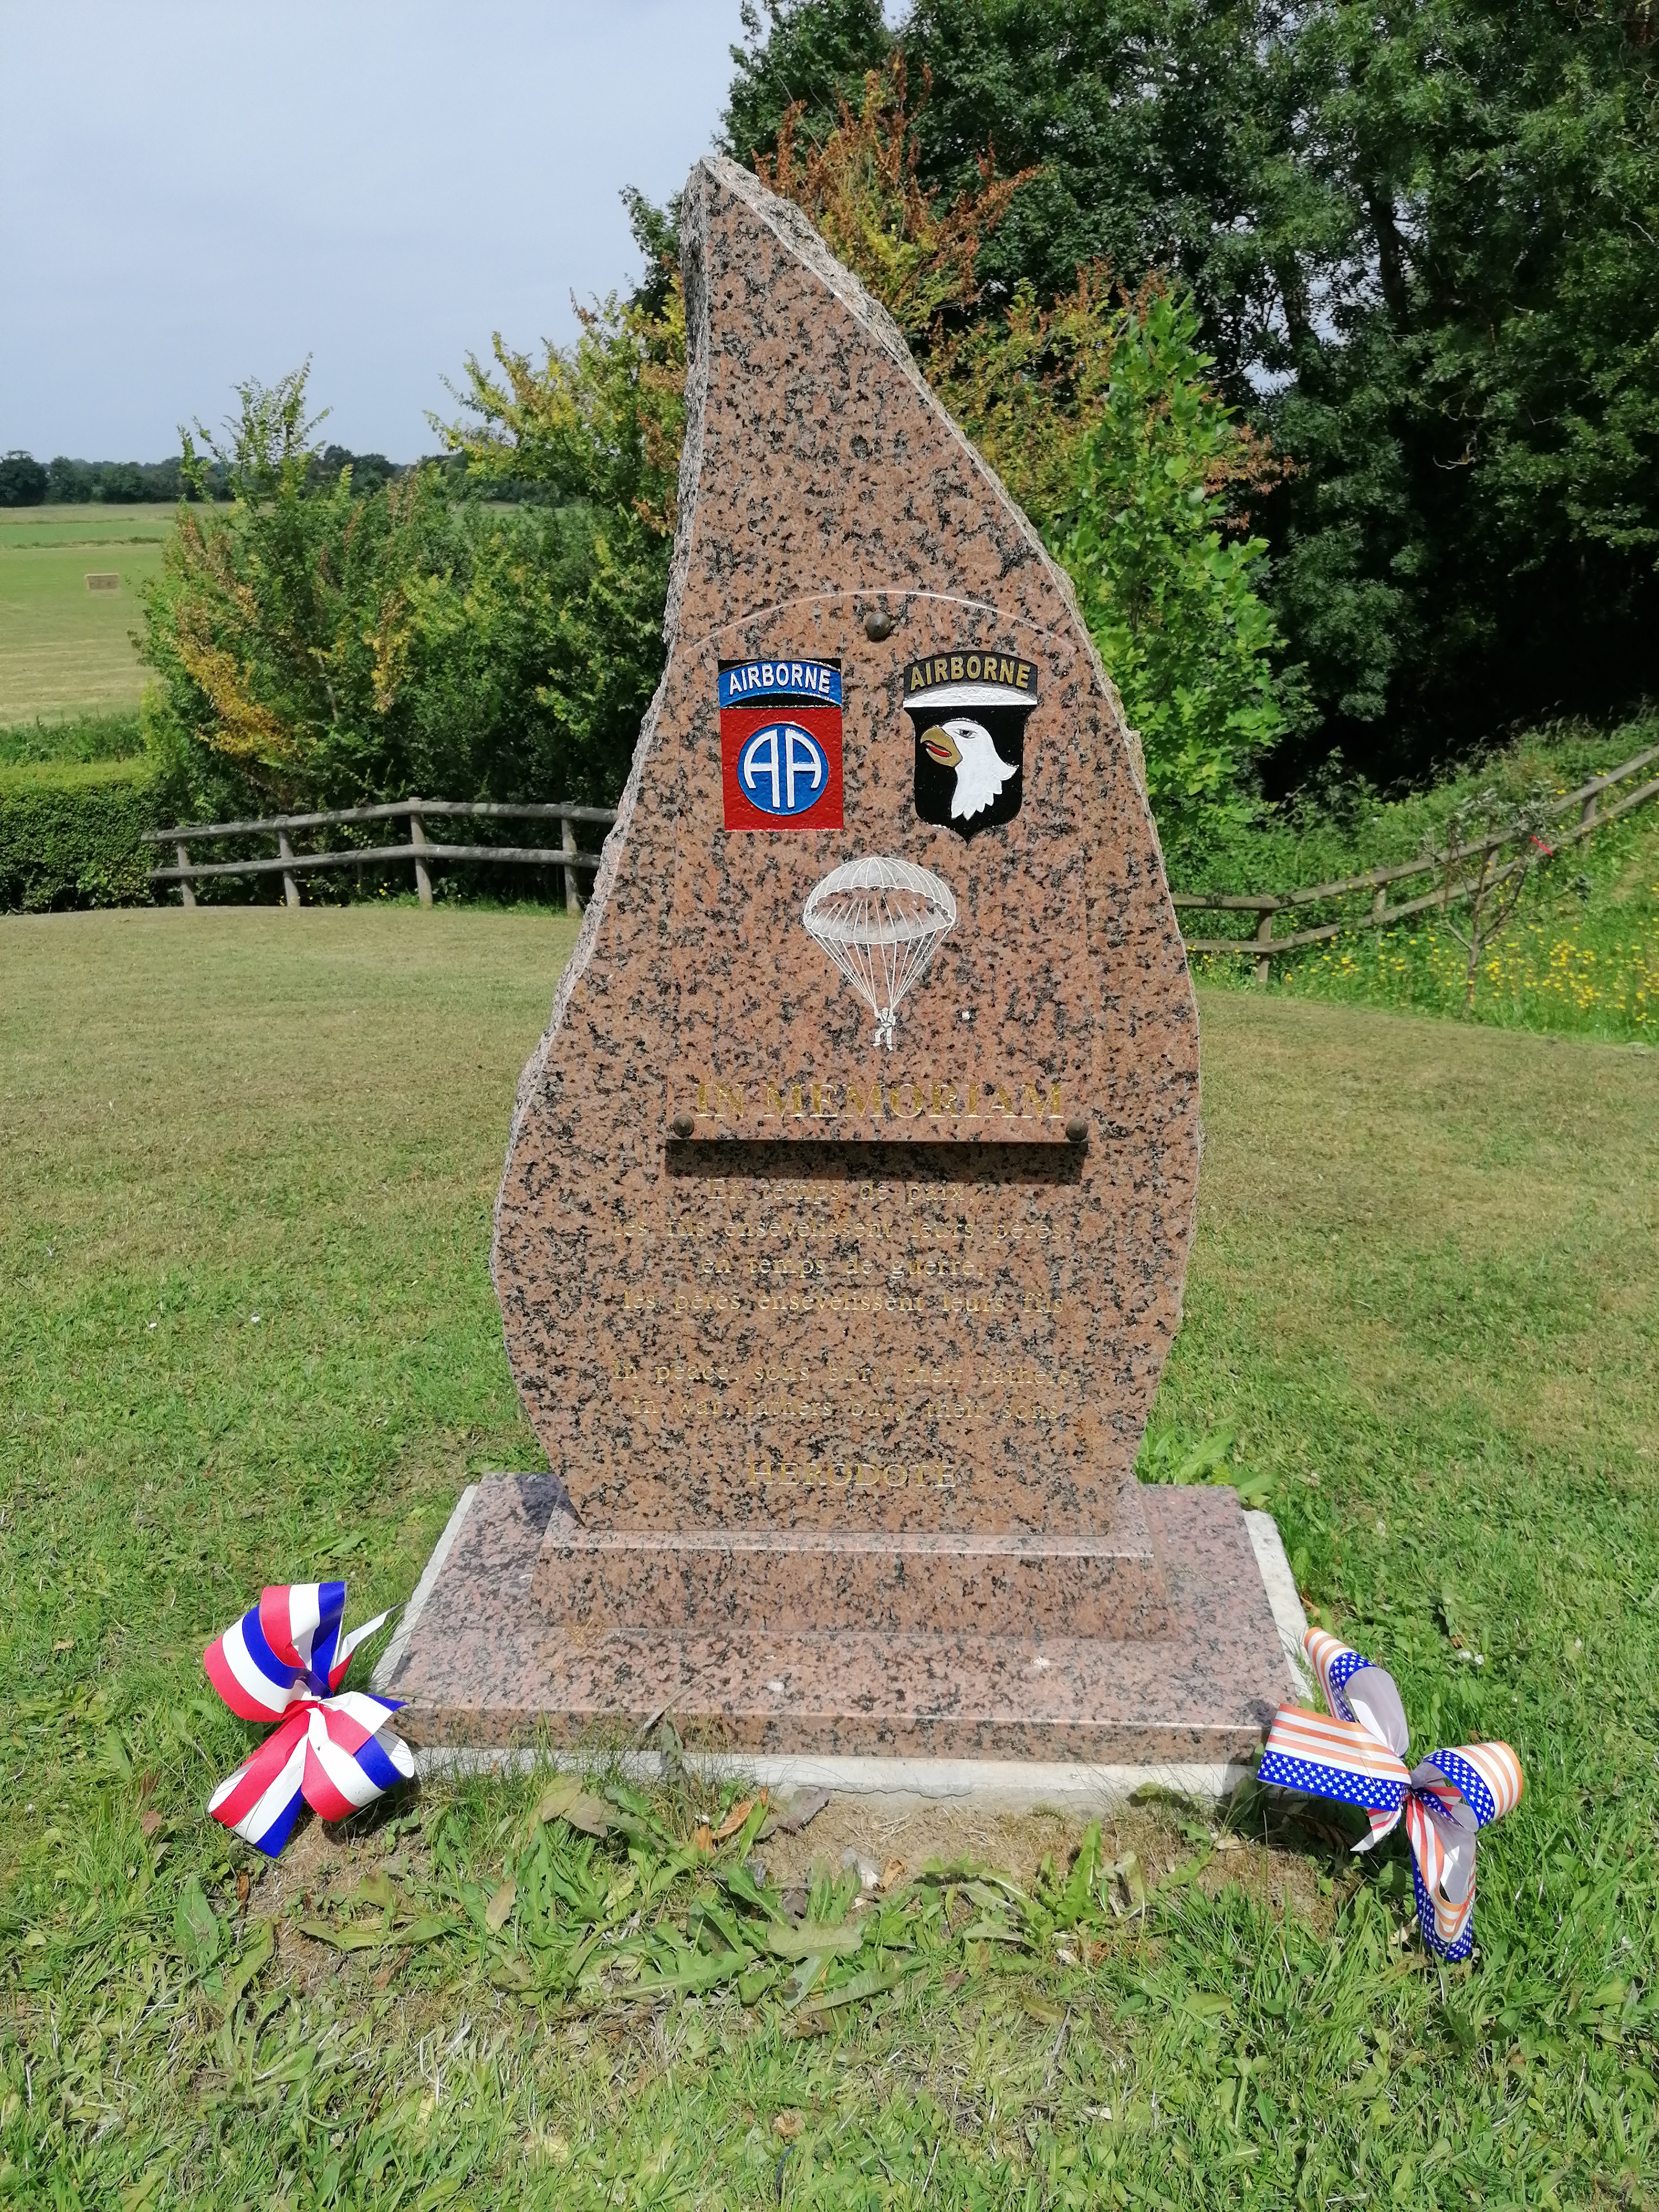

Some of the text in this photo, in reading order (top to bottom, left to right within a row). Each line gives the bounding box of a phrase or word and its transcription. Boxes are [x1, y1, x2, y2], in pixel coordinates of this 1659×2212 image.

[728, 663, 831, 695] AIRBORNE
[910, 655, 1030, 691] AIRBORNE
[744, 728, 823, 808] AA
[693, 1083, 1066, 1118] IN MEMORIAM
[707, 1179, 973, 1205] En temps de paix,
[614, 1216, 1071, 1243] les fils ensevelissent leurs pères,
[702, 1255, 984, 1279] en temps de guerre,
[623, 1289, 656, 1309] les
[758, 1290, 924, 1312] ensevelissent
[942, 1291, 1004, 1312] leurs
[1022, 1292, 1064, 1313] fils
[612, 1360, 1078, 1388] In peace, sons bury their fathers,
[632, 1395, 1058, 1421] In war, fathers bury their sons
[746, 1462, 956, 1488] HERODOTE
